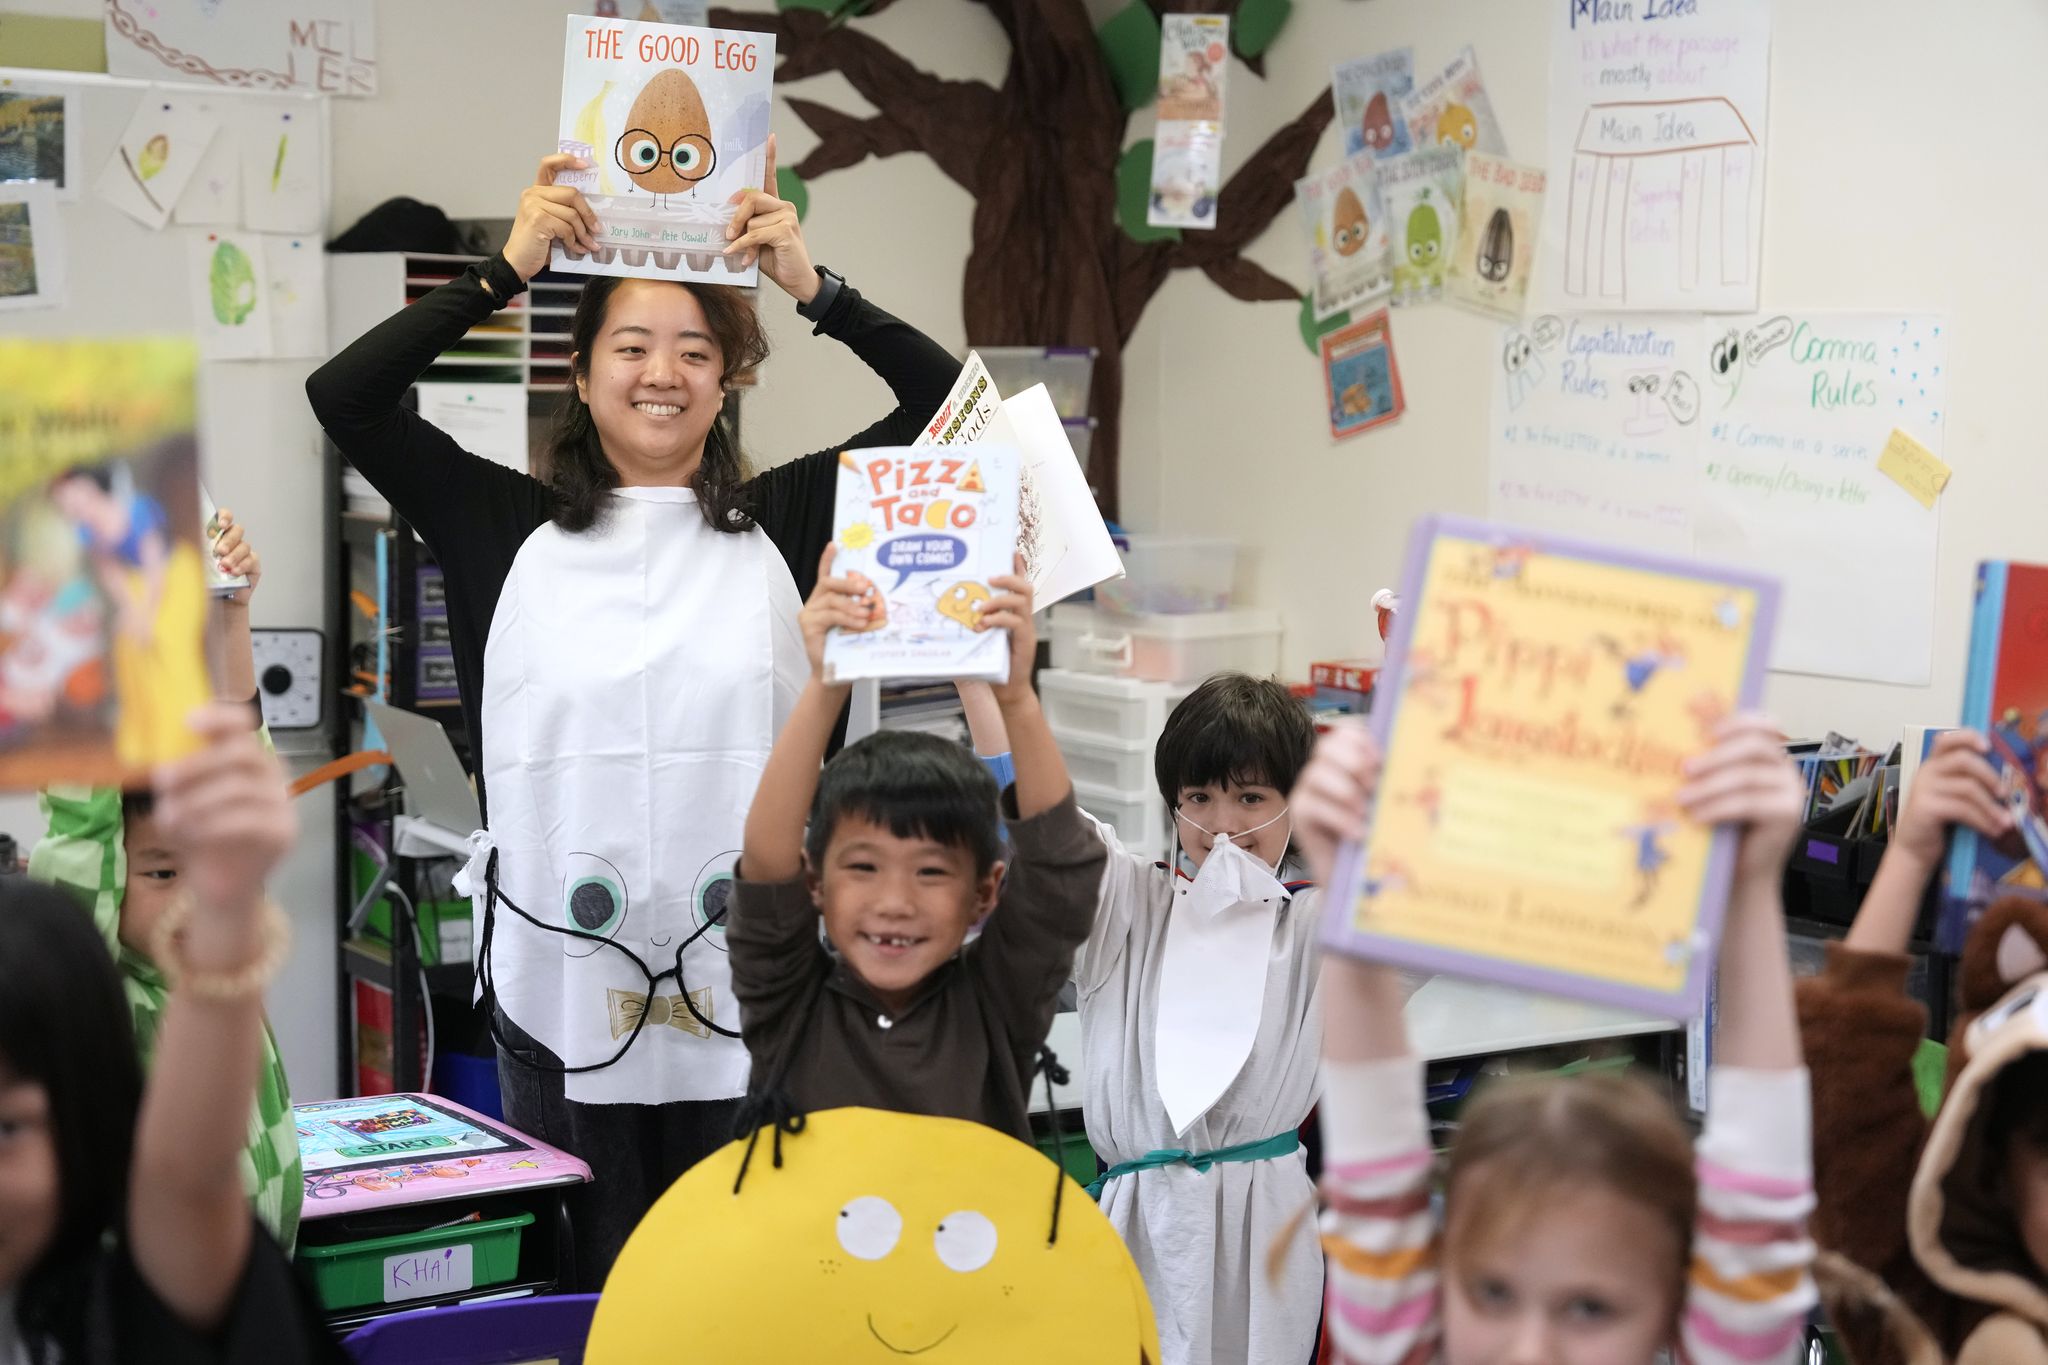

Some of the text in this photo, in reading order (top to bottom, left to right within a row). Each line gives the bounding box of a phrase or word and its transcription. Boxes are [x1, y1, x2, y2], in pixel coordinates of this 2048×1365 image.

[585, 29, 756, 72] THE GOOD EGG
[1600, 62, 1652, 91] mostly
[1600, 111, 1697, 142] Main Idea
[610, 226, 708, 243] Jory John Pete Oswald
[1790, 321, 1878, 365] Comma
[928, 400, 952, 440] Asterix
[957, 362, 980, 400] UDERZO
[1811, 369, 1876, 411] Rules
[937, 376, 987, 445] NSIONS
[908, 487, 940, 498] and
[358, 1138, 432, 1153] START
